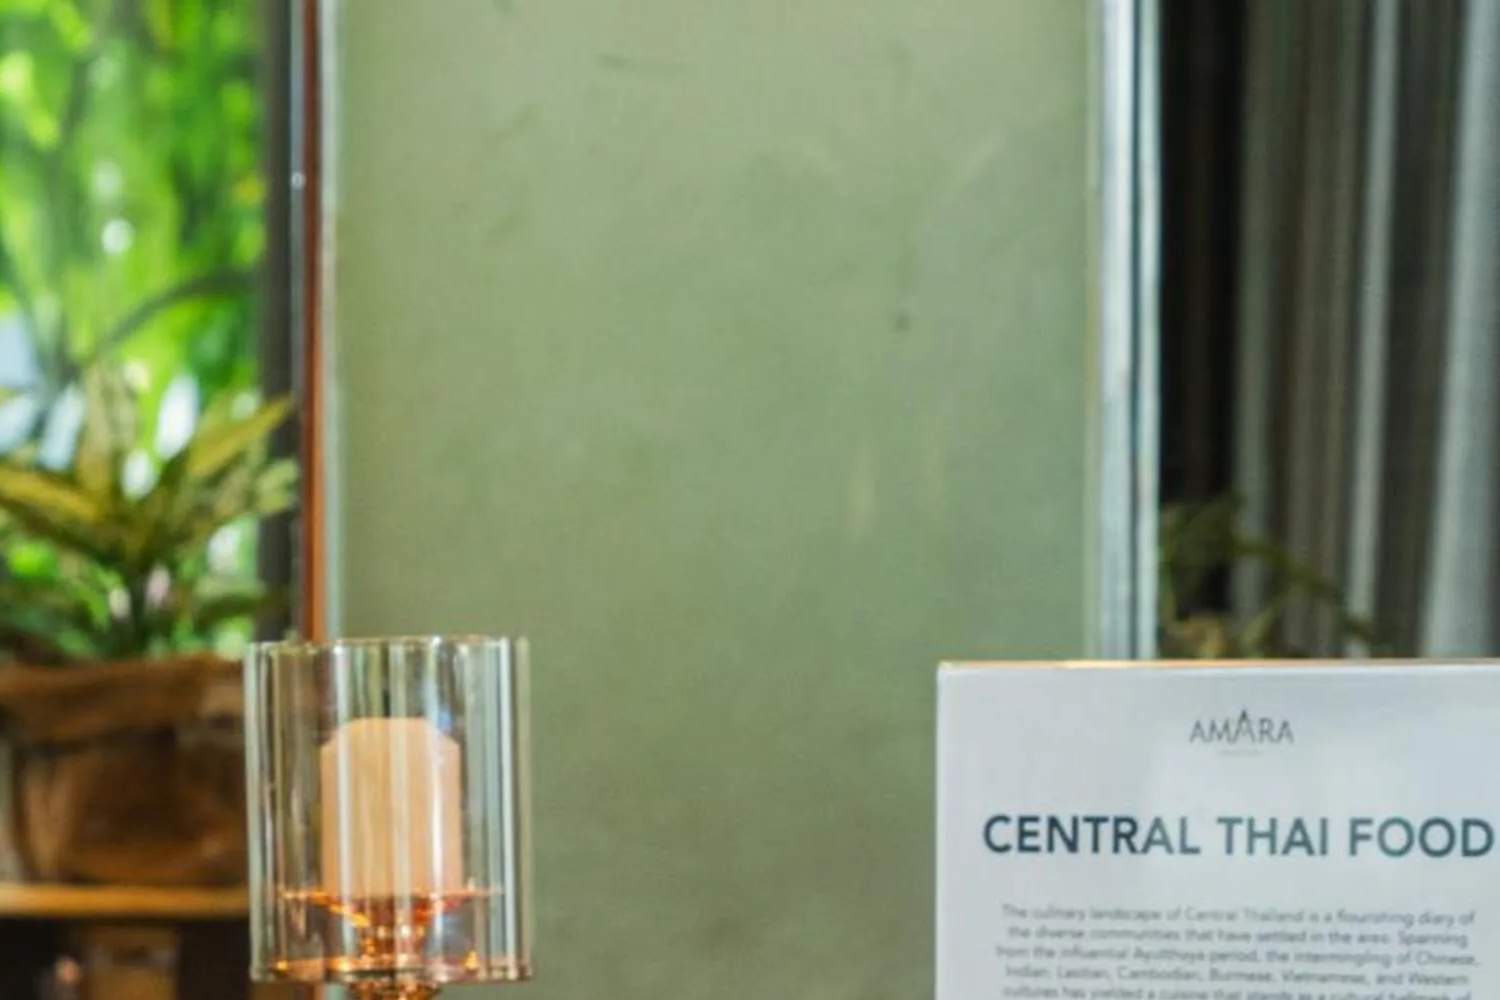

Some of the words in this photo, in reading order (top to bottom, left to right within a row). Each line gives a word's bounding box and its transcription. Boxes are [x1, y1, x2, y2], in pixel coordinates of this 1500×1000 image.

[1189, 709, 1294, 744] AMARA
[983, 814, 1200, 855] CENTRAL
[1217, 816, 1328, 856] THAI
[1348, 817, 1496, 858] FOOD
